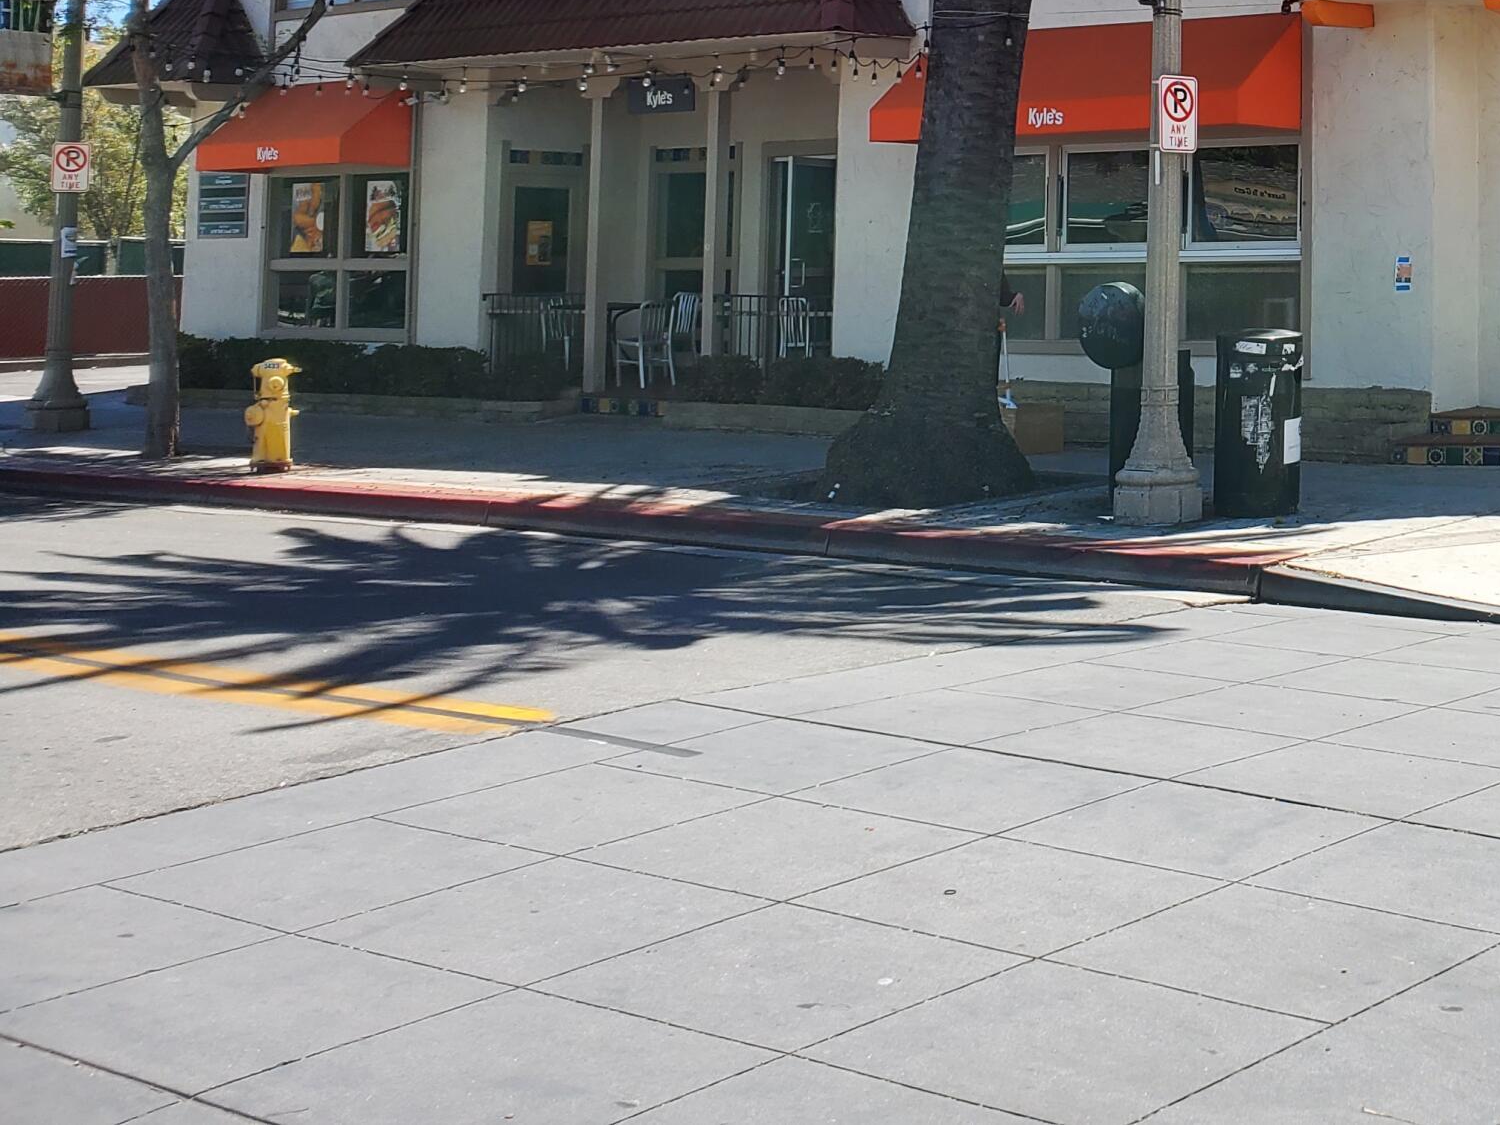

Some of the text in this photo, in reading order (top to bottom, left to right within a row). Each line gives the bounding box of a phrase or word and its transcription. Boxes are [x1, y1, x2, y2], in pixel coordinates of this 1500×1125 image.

[646, 90, 673, 108] Kyle's
[1028, 107, 1064, 128] Kyle's
[1170, 125, 1187, 135] ANY
[1169, 136, 1189, 147] TIME
[256, 147, 279, 163] Kyle's
[62, 173, 79, 181] ANY
[60, 181, 81, 189] TIME
